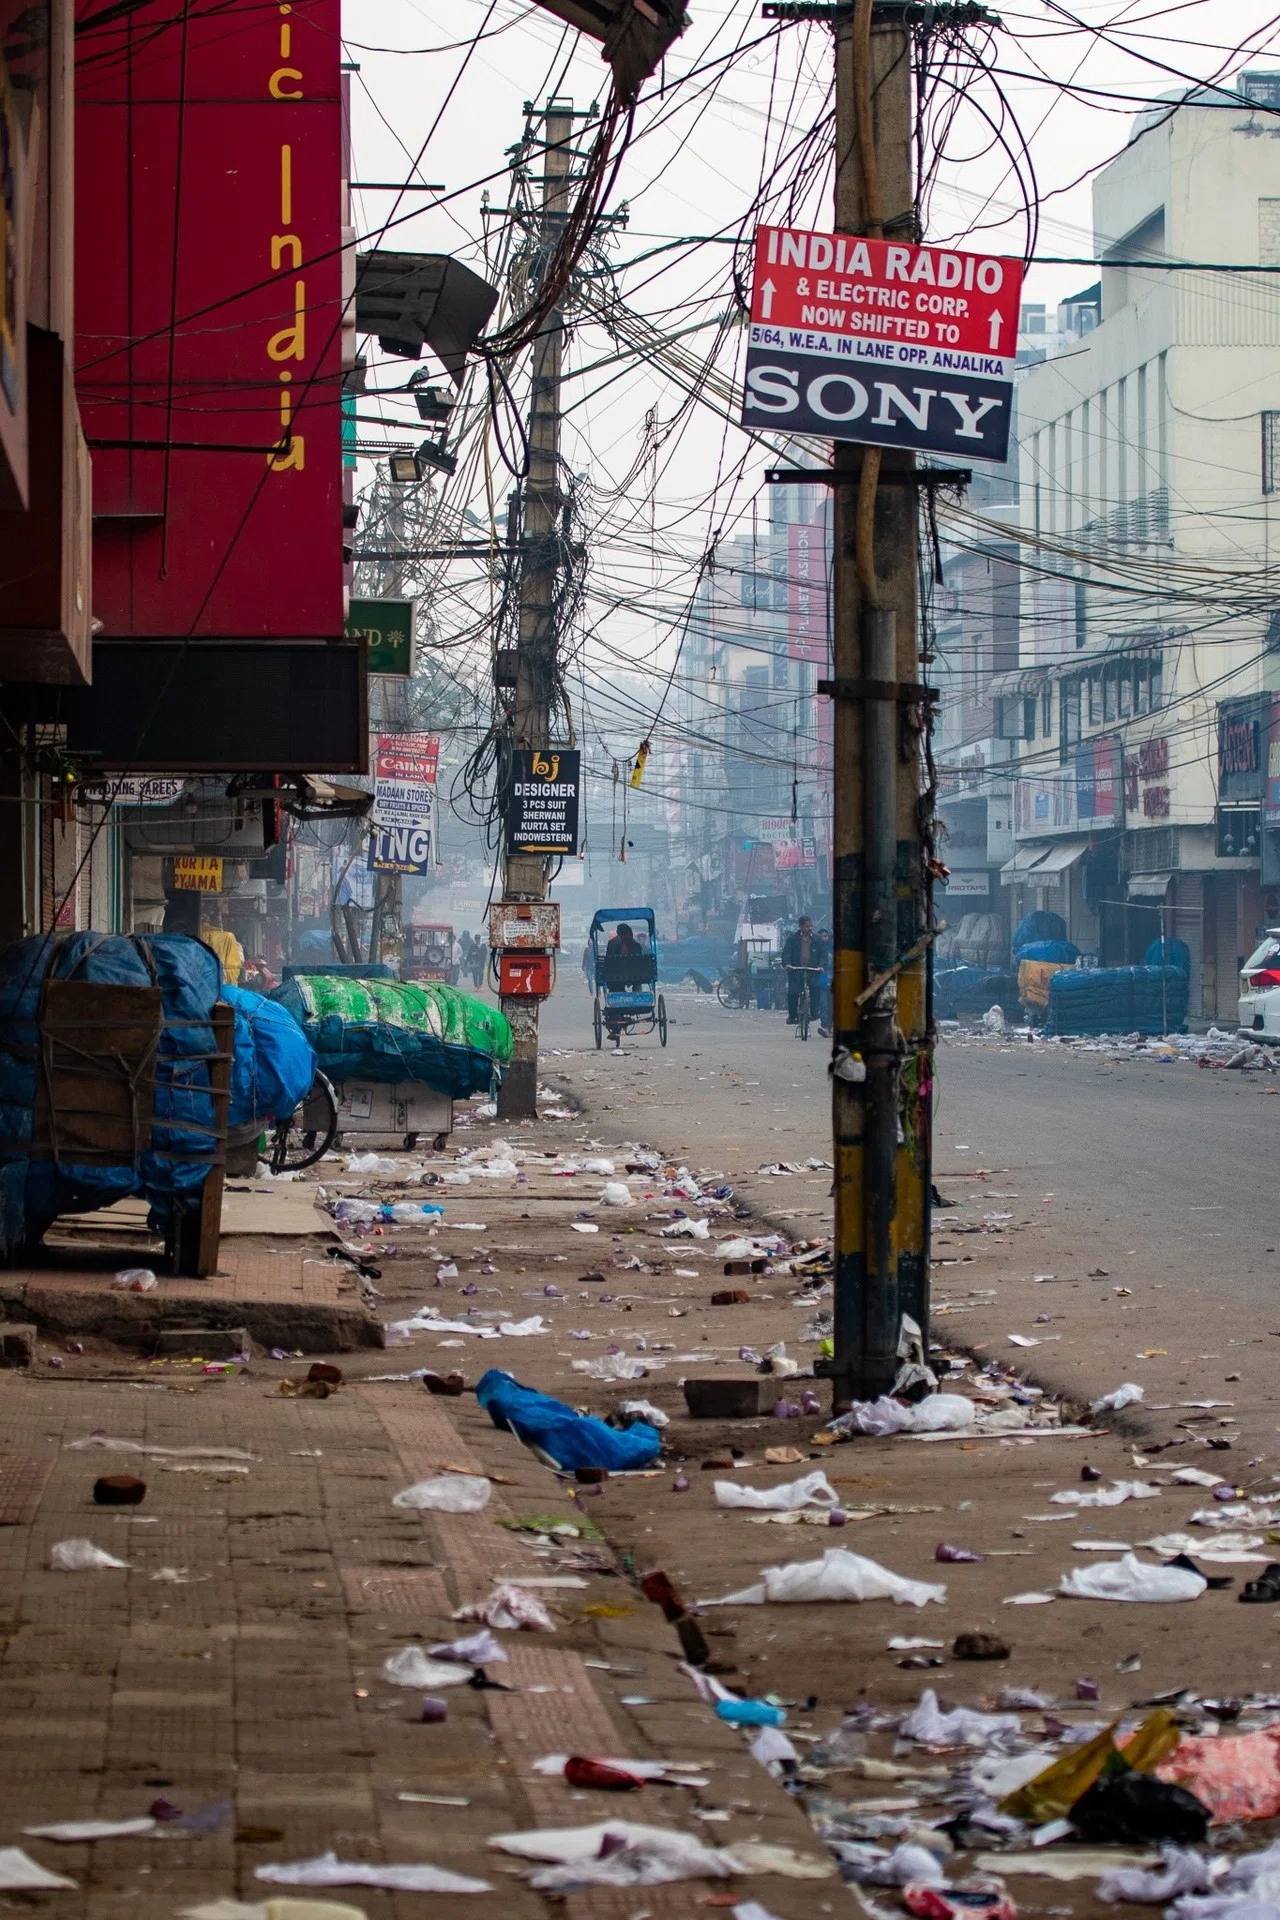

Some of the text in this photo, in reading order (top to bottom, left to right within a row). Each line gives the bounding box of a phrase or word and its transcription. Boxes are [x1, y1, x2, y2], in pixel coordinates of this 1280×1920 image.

[767, 230, 1004, 294] INDIA RADIO
[796, 277, 969, 318] & ELECTRIC CORP.
[801, 306, 960, 343] NOW SHIFTED TO
[751, 327, 1004, 376] 5/64, W.E.A. IN LANE OPP. ANJALIKA
[746, 365, 1003, 440] SONY
[380, 757, 436, 774] Canon
[532, 752, 560, 781] bj
[139, 780, 179, 795] SAREES
[377, 785, 405, 800] MADAAN
[406, 788, 433, 803] STORES
[514, 783, 575, 797] DESIGNER
[389, 802, 406, 811] FRUITS
[411, 804, 428, 812] SPICES
[522, 800, 567, 809] 3 PCS SUIT
[523, 811, 566, 820] SHERWANI
[521, 822, 566, 831] KURTA SET
[375, 827, 428, 863] TNG
[514, 832, 573, 842] INDOWESTERN
[174, 874, 218, 891] PYJAMA
